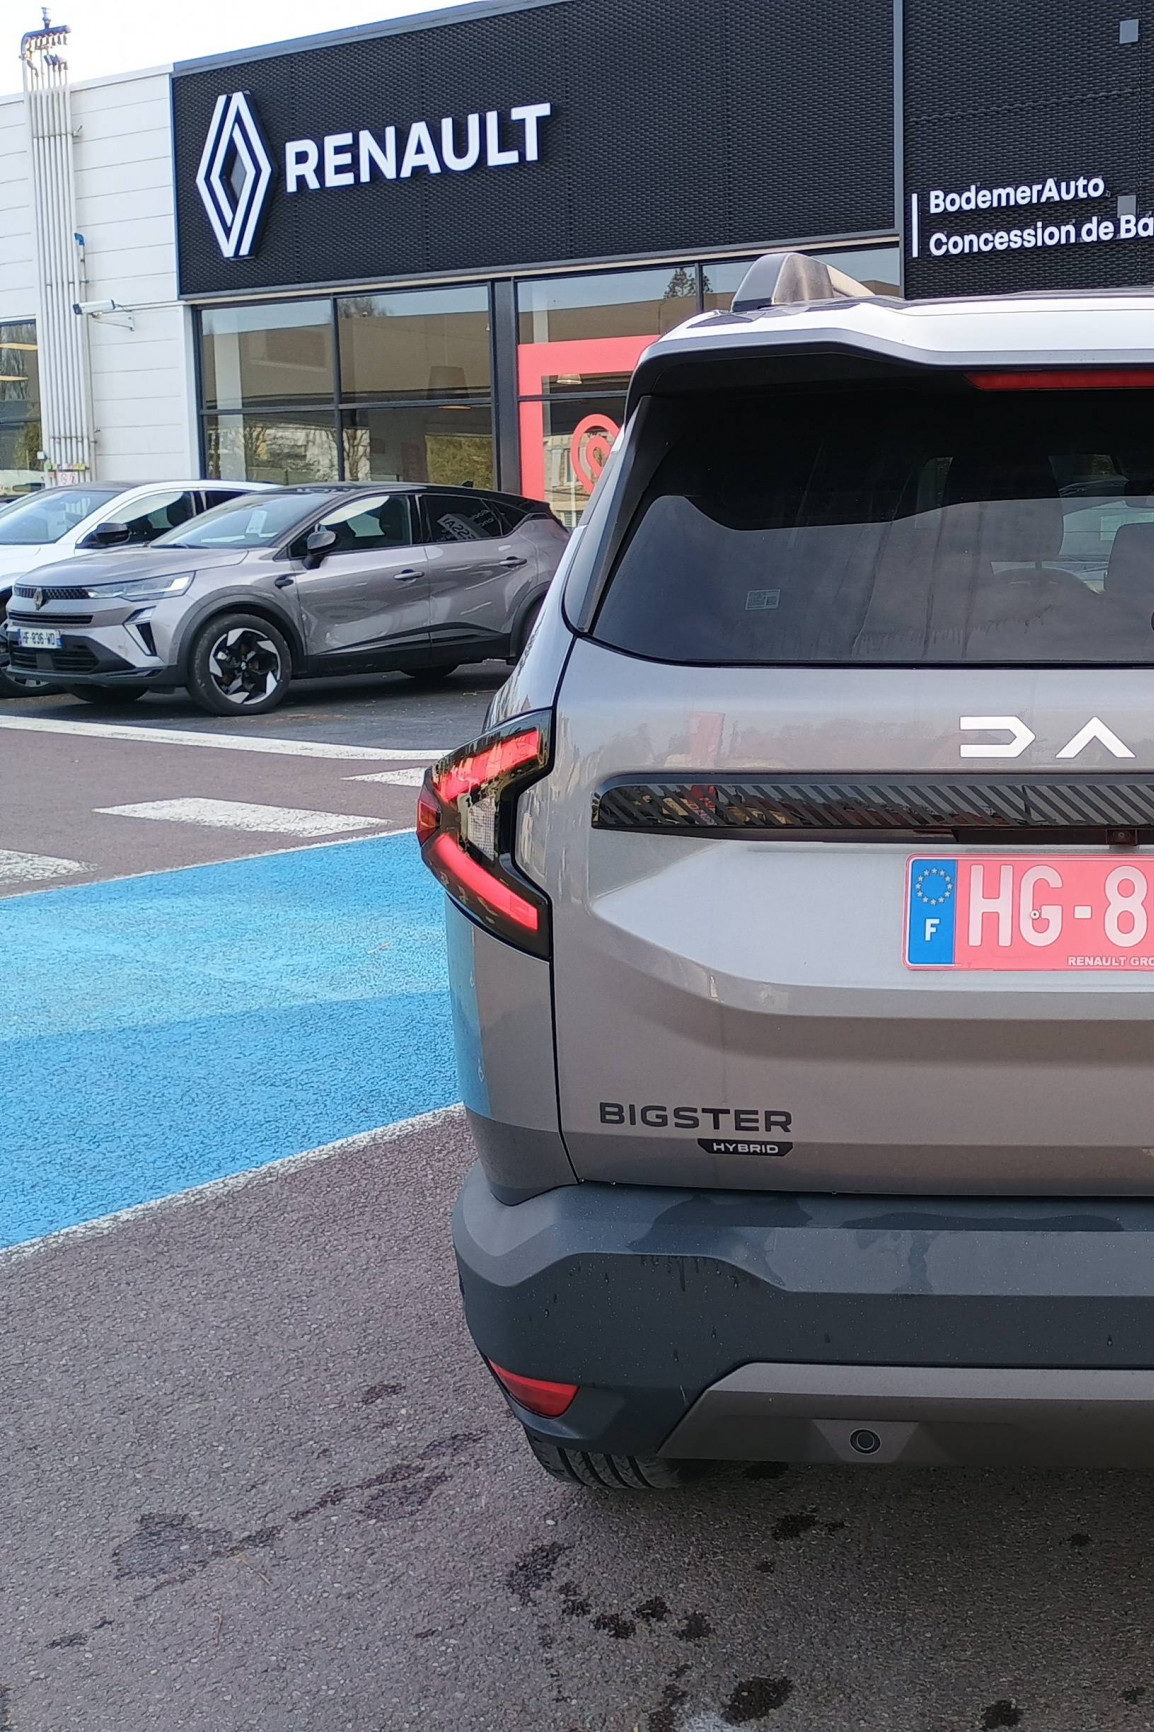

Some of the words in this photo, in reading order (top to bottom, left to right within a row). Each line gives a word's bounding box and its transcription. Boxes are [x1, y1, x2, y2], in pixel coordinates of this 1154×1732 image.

[284, 102, 551, 193] RENAULT
[929, 176, 1105, 214] BodemerAuto
[929, 221, 1076, 256] Concession
[1081, 216, 1115, 242] de
[924, 918, 941, 942] F
[1067, 956, 1126, 967] RENAULT
[599, 1102, 793, 1133] BIGSTER
[712, 1141, 779, 1154] HYBRID
